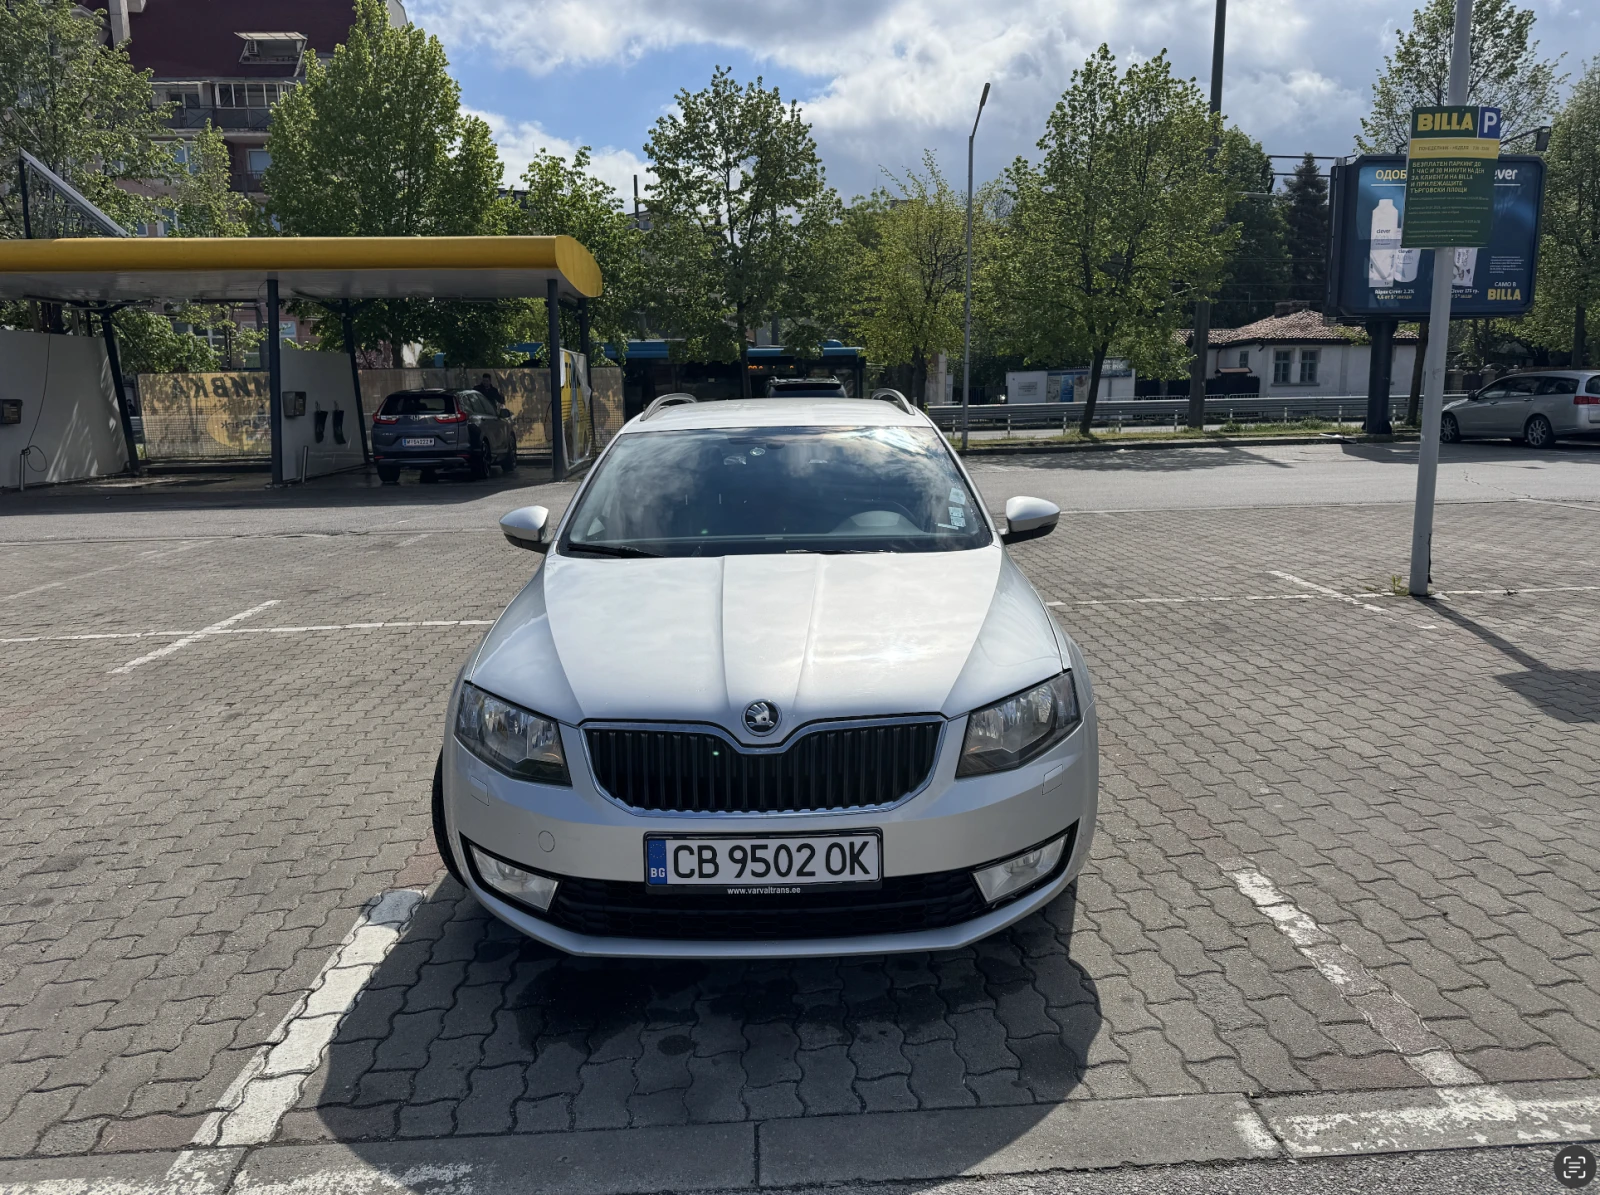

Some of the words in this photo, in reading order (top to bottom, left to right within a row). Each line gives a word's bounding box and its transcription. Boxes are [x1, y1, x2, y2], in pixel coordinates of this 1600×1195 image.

[1417, 112, 1474, 131] BILLA
[1483, 111, 1498, 133] P
[1375, 169, 1407, 181] ОДОБ
[1487, 288, 1521, 300] BILLA
[673, 844, 720, 879] CB
[728, 843, 816, 879] 9502
[825, 841, 871, 876] OK
[650, 867, 665, 878] BG
